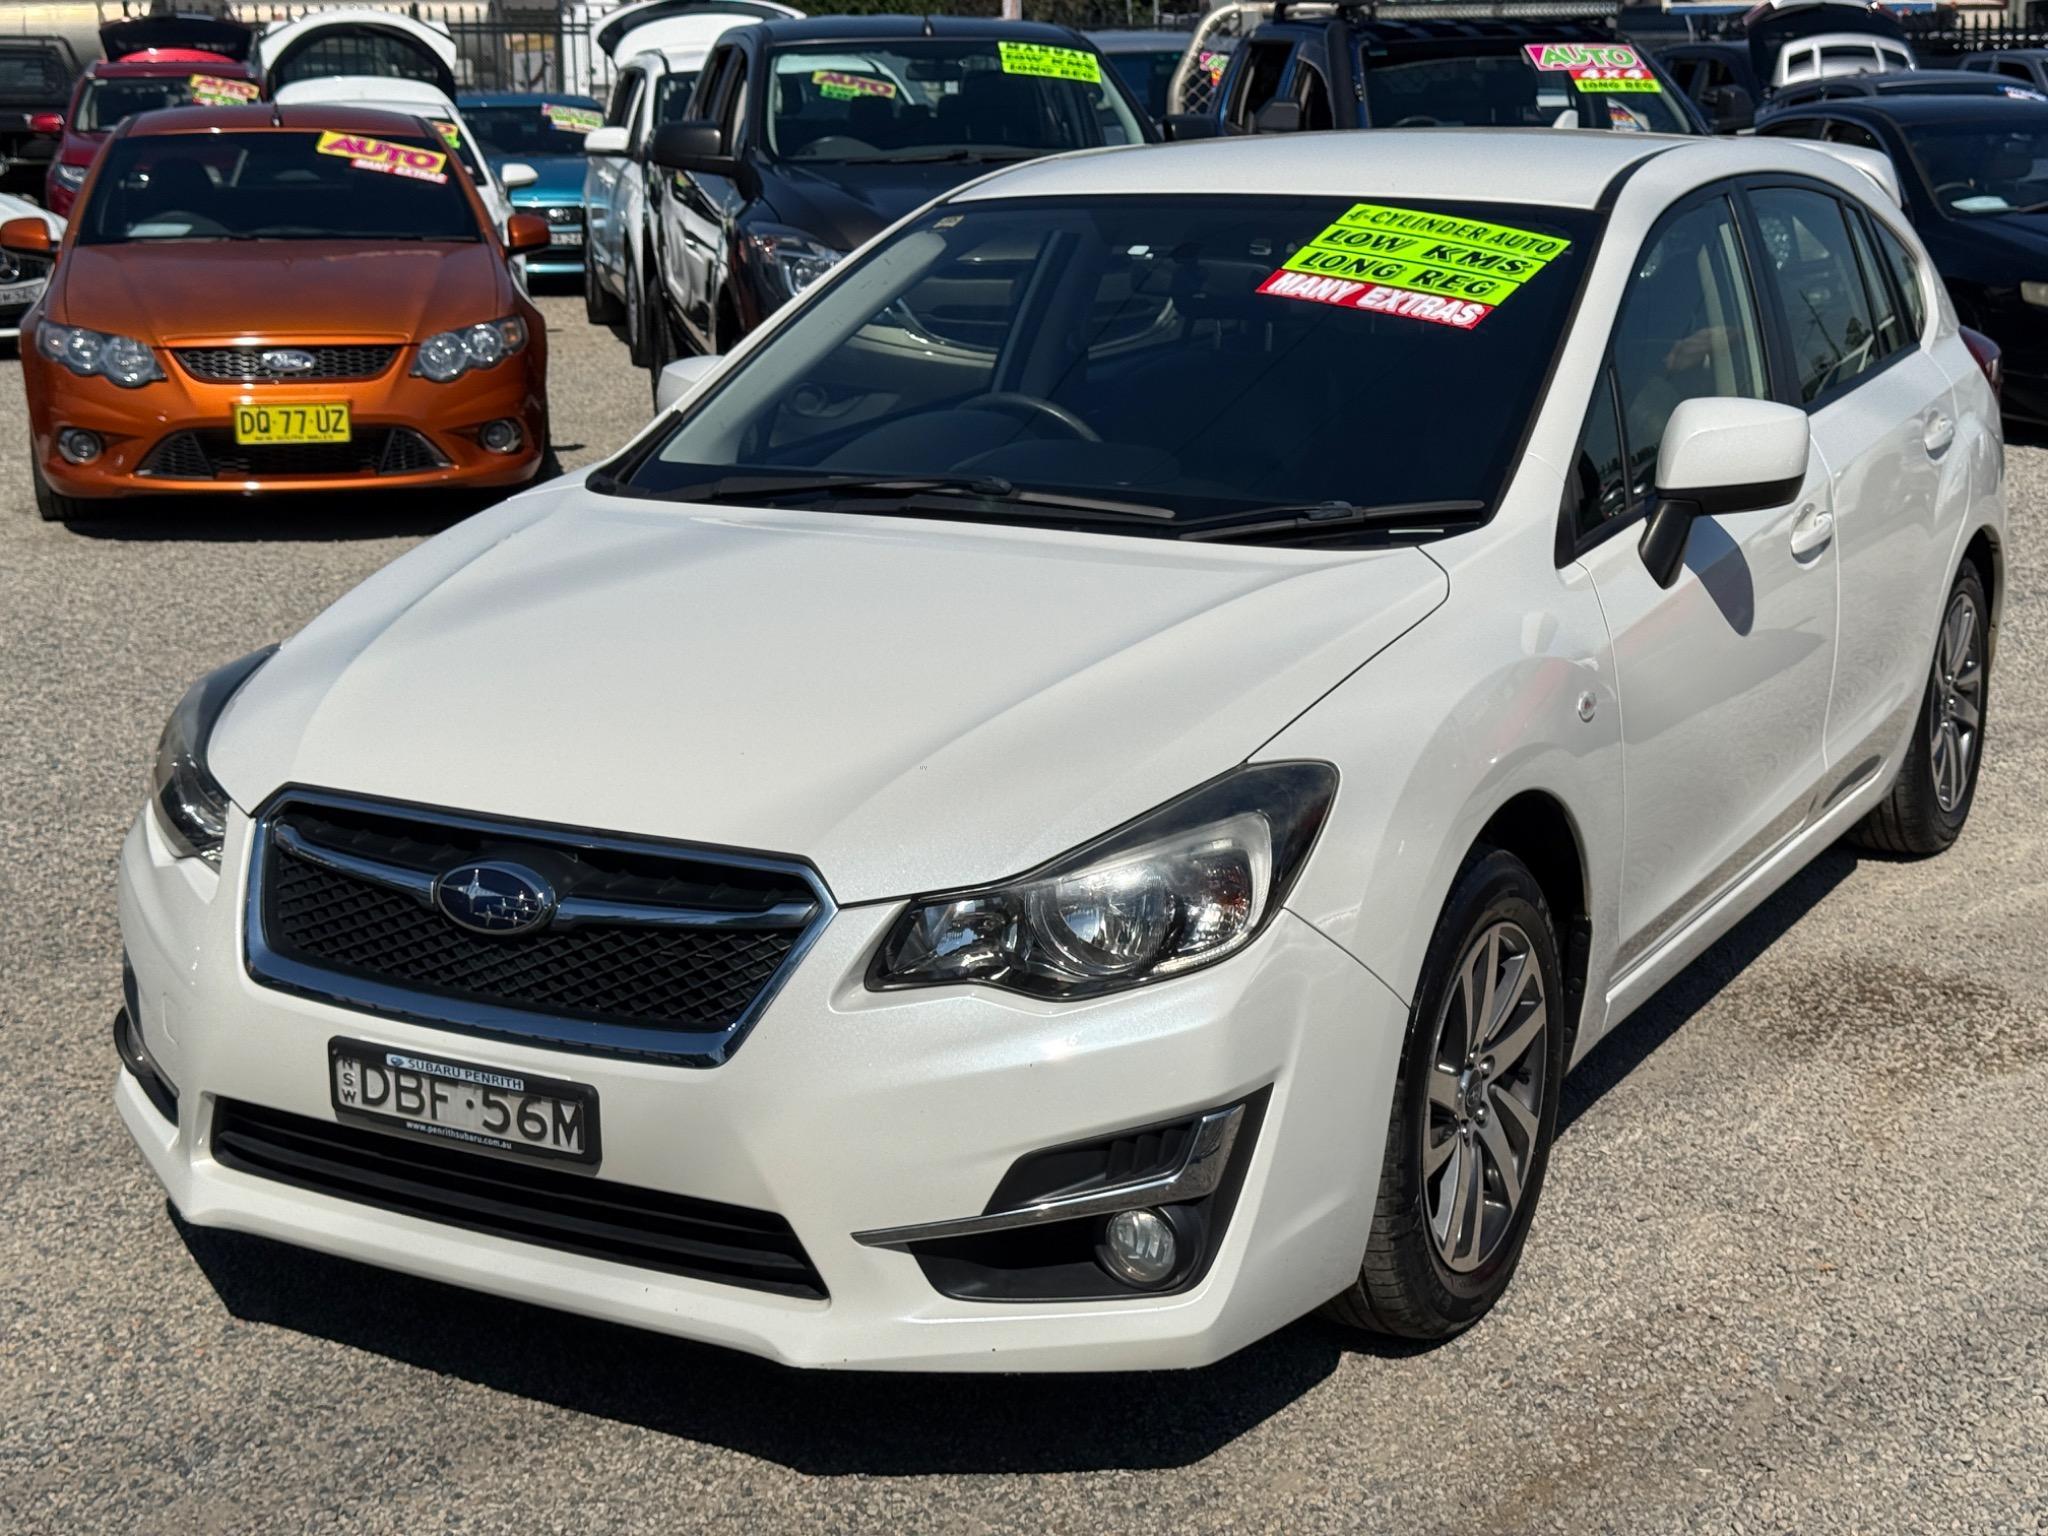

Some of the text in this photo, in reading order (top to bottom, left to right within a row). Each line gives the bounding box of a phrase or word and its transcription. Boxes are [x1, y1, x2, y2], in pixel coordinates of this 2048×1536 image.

[1542, 45, 1636, 68] AUTO
[196, 78, 256, 96] AUTO
[820, 72, 892, 94] AUTO
[1582, 81, 1621, 89] LONG
[326, 136, 439, 168] AUTO
[1347, 206, 1560, 255] 4-CYLINDER AUTO
[1322, 228, 1534, 276] LOW KMS
[1297, 251, 1501, 297] LONG REG
[1267, 272, 1485, 326] MANY EXTRAS
[407, 1058, 523, 1090] SUBARU PENRITH
[406, 1120, 513, 1150] www.penrithsubaru.com.au
